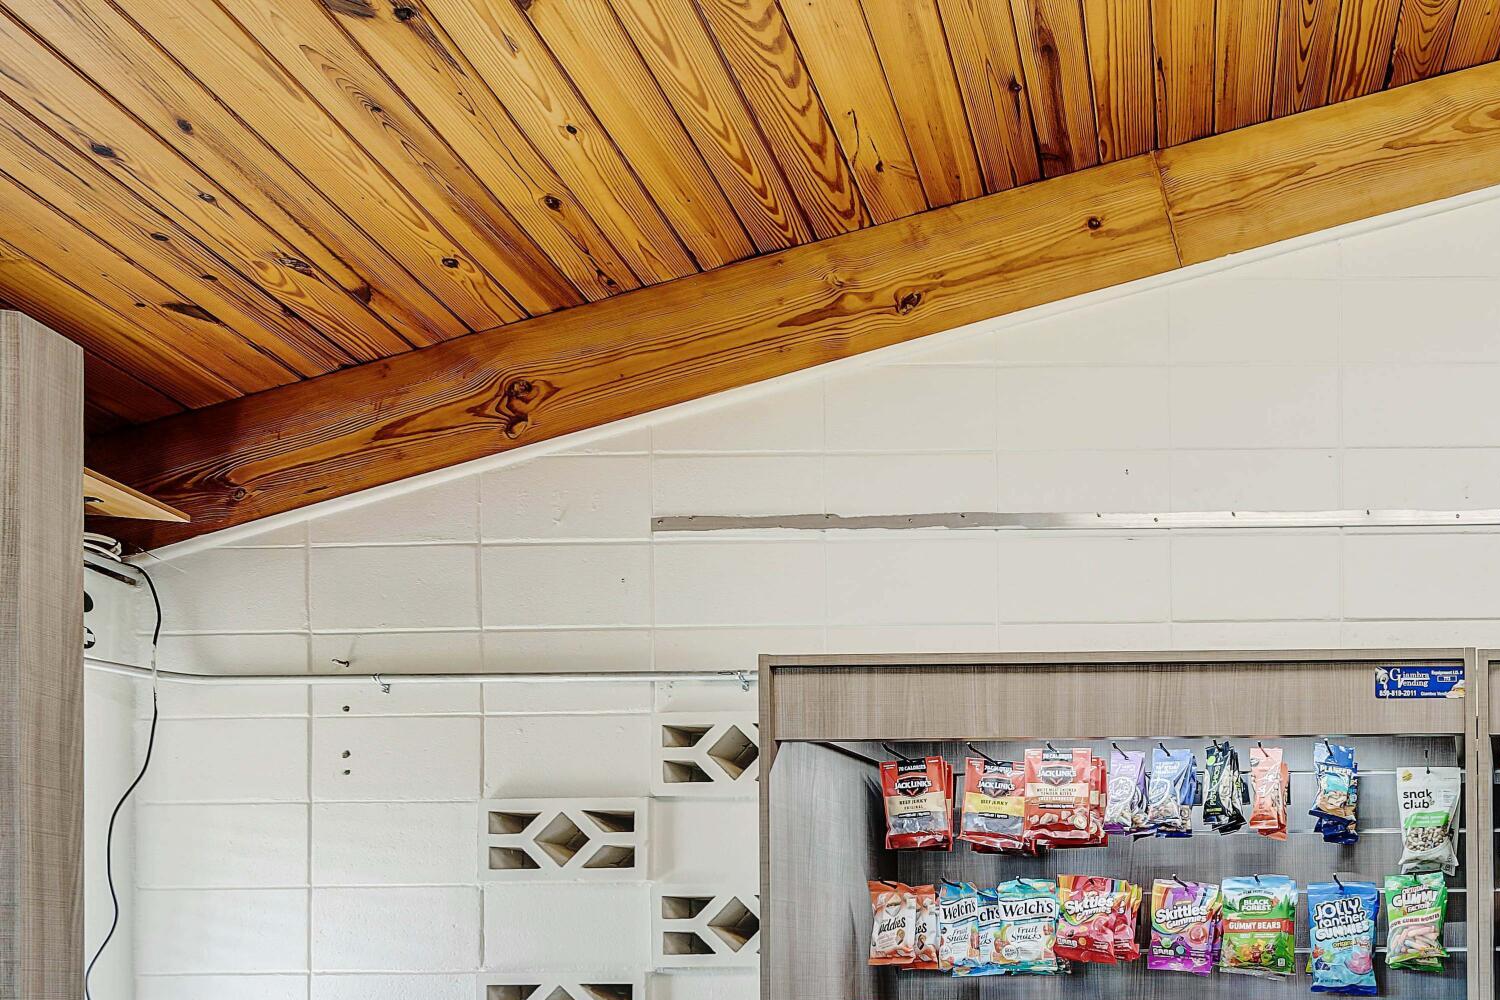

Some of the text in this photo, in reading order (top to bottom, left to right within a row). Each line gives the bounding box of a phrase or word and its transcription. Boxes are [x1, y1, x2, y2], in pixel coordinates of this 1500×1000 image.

[1389, 668, 1431, 681] Giambra
[1397, 677, 1428, 688] Vending
[895, 780, 932, 789] JACK LINK'S
[1403, 788, 1432, 801] snak
[1403, 799, 1430, 810] club
[942, 900, 976, 920] Welch's
[1002, 900, 1054, 918] Welch's
[1241, 904, 1272, 912] FOREST
[1314, 897, 1361, 921] JOLLY
[1017, 925, 1038, 935] Fruit
[1228, 921, 1281, 930] GUMMY BEARS
